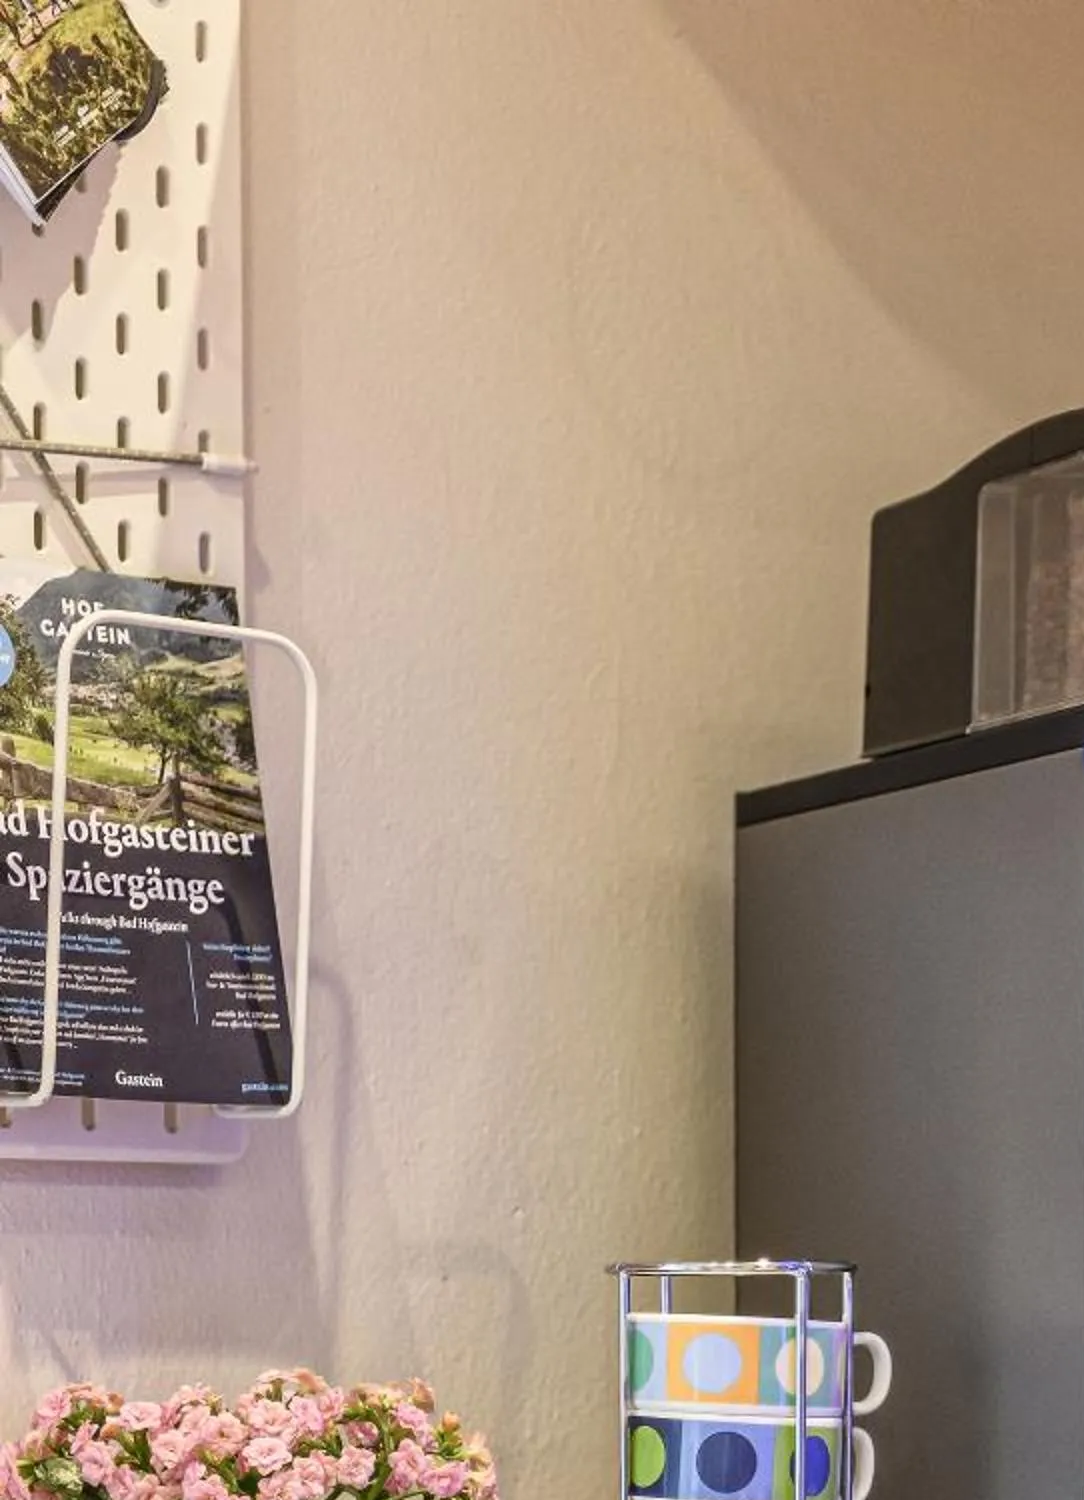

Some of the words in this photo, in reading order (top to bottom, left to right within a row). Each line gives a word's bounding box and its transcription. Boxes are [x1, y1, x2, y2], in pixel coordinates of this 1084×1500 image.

[61, 597, 105, 617] HOF
[40, 618, 131, 645] GATEIN
[6, 851, 225, 914] Spziergänge
[115, 1069, 164, 1088] Gastein
